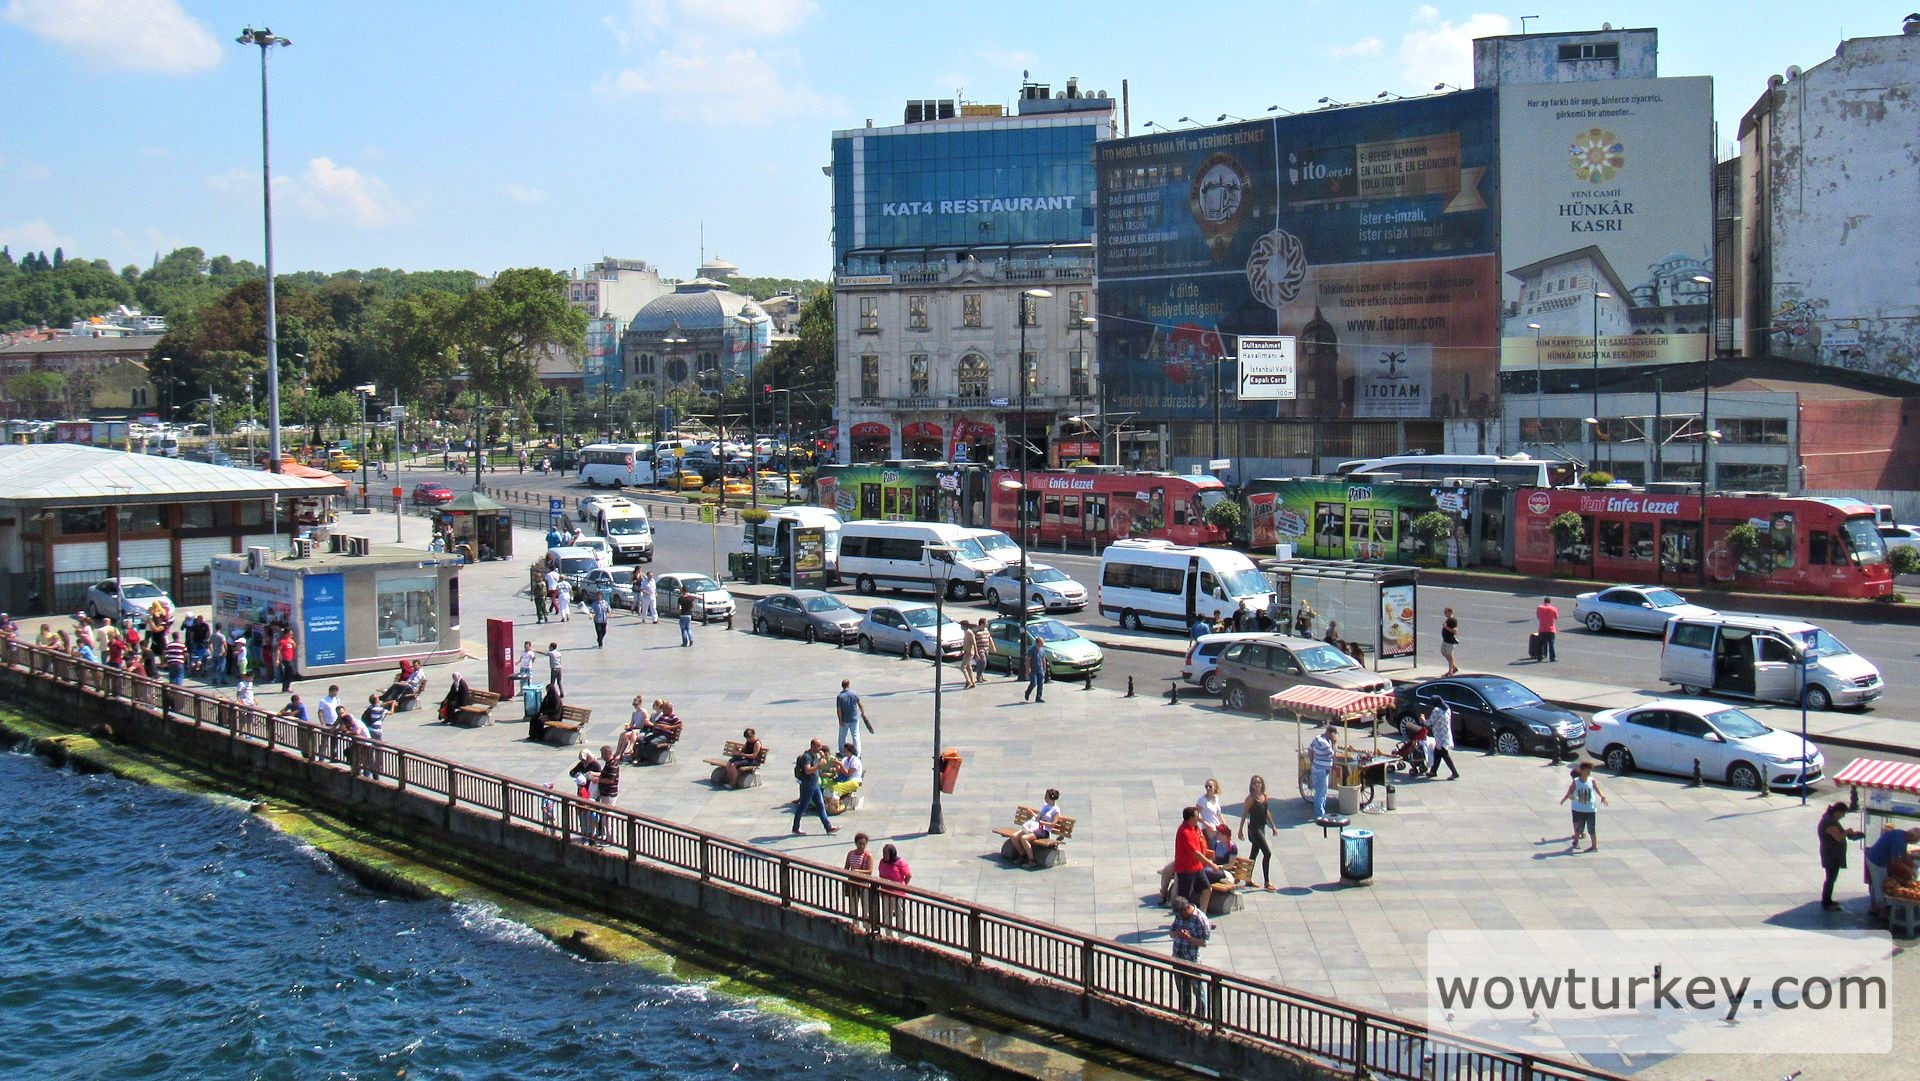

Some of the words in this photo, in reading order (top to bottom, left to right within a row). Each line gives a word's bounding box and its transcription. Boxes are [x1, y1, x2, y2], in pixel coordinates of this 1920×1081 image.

[1527, 100, 1539, 108] Her
[1570, 98, 1579, 106] bir
[1587, 109, 1597, 118] bir
[1153, 141, 1175, 155] DAHA
[1187, 141, 1198, 151] ve
[1198, 132, 1233, 149] YERİNDE
[1234, 128, 1264, 145] HİZMET
[1360, 149, 1392, 163] E-BELGE
[1360, 164, 1373, 177] EN
[1373, 163, 1392, 176] HIZLI
[1393, 162, 1403, 173] VE
[1405, 160, 1415, 173] EN
[1360, 177, 1380, 190] YOLU
[882, 200, 933, 216] KAT4
[940, 195, 1076, 215] RESTAURANT
[1559, 200, 1634, 216] HÜNKÂR
[1570, 219, 1623, 232] KASRI
[1169, 284, 1175, 298] 4
[1176, 282, 1199, 297] dilde
[1148, 302, 1182, 320] faaliyet
[1347, 315, 1445, 332] www.itotam.com
[1242, 341, 1281, 349] Sultanahmet
[860, 424, 879, 434] KFC
[1048, 477, 1069, 489] Enfes
[1070, 477, 1094, 490] Lezzet
[1580, 495, 1606, 512] Yeni
[1607, 497, 1639, 513] Enfes
[1641, 498, 1680, 514] Lezzet
